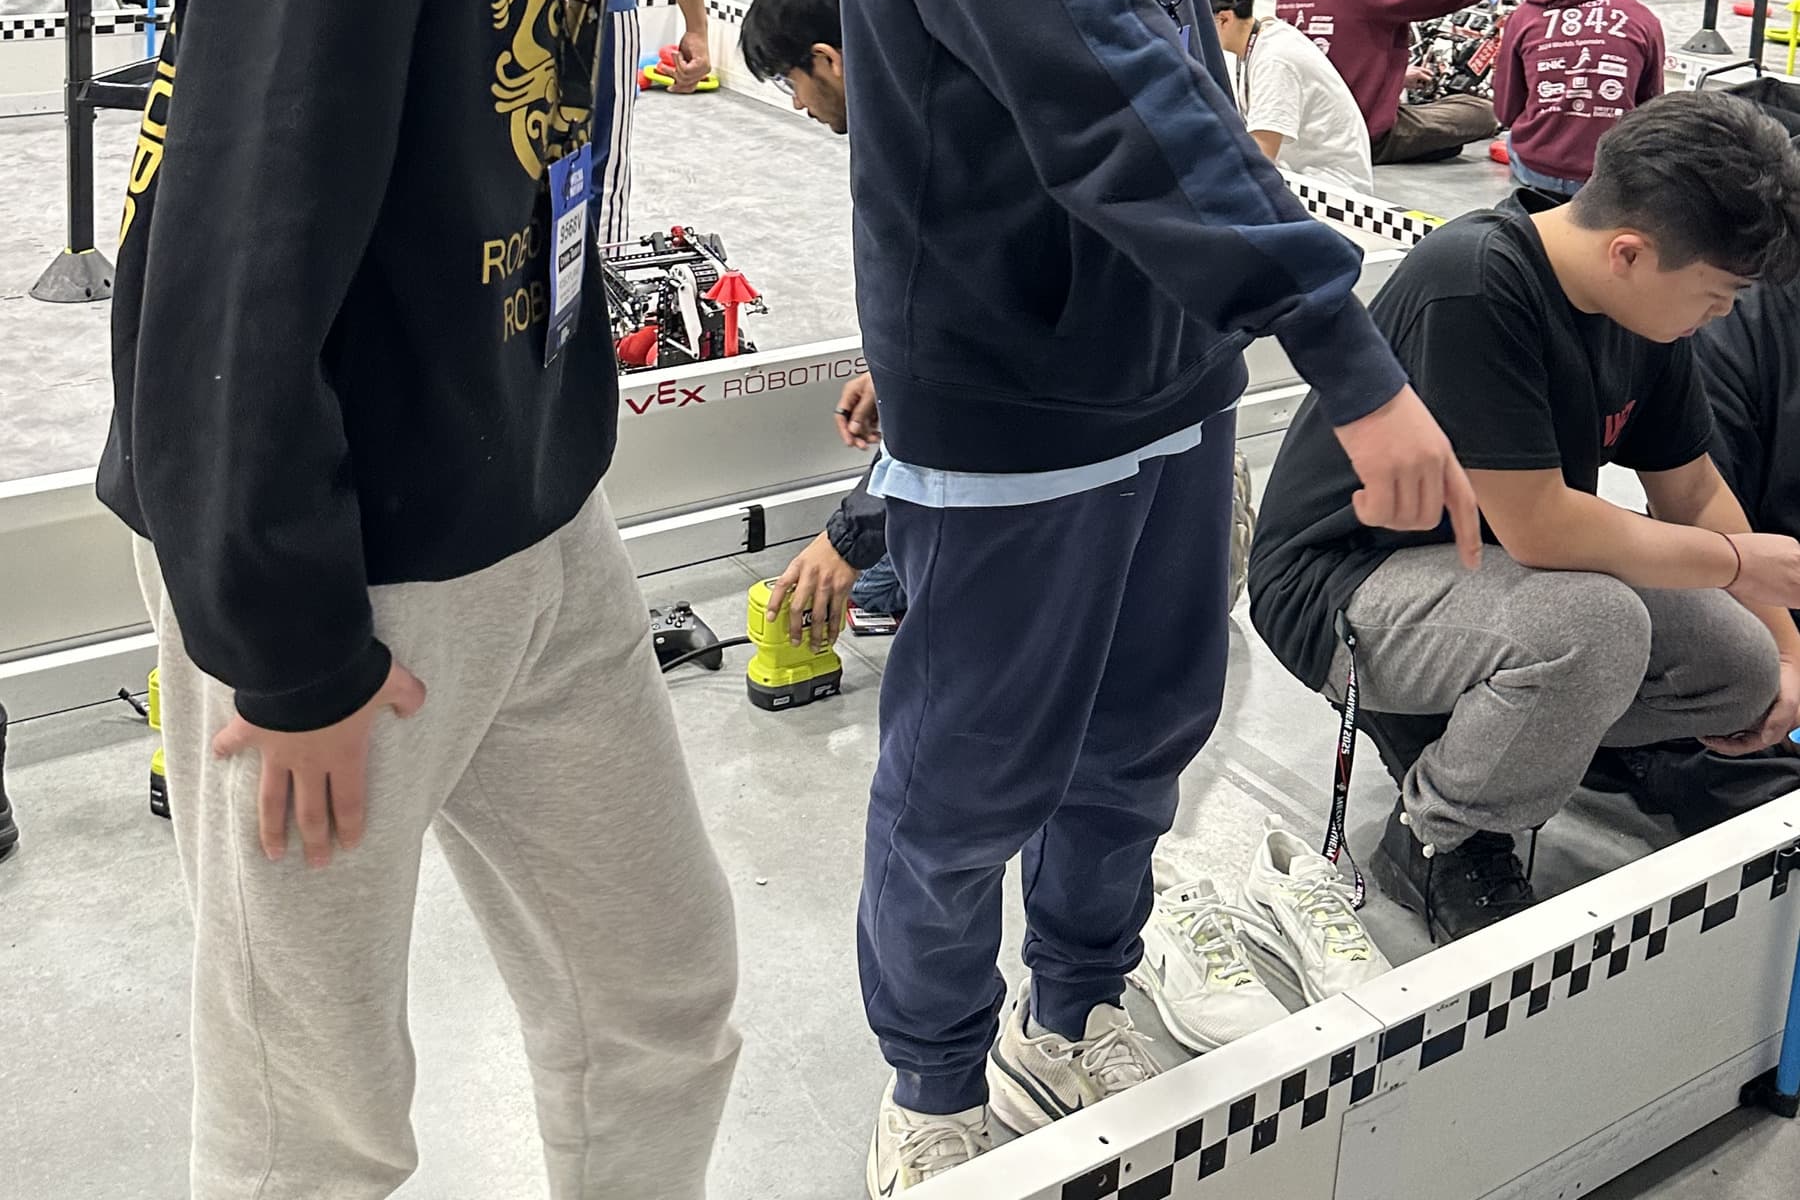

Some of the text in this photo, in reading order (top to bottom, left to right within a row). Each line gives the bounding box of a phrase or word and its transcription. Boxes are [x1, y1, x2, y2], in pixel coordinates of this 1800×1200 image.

[1542, 7, 1629, 39] 7842
[625, 356, 870, 415] VEX ROBOTICS
[1342, 683, 1359, 730] MAYHEM
[1340, 730, 1352, 755] 2025
